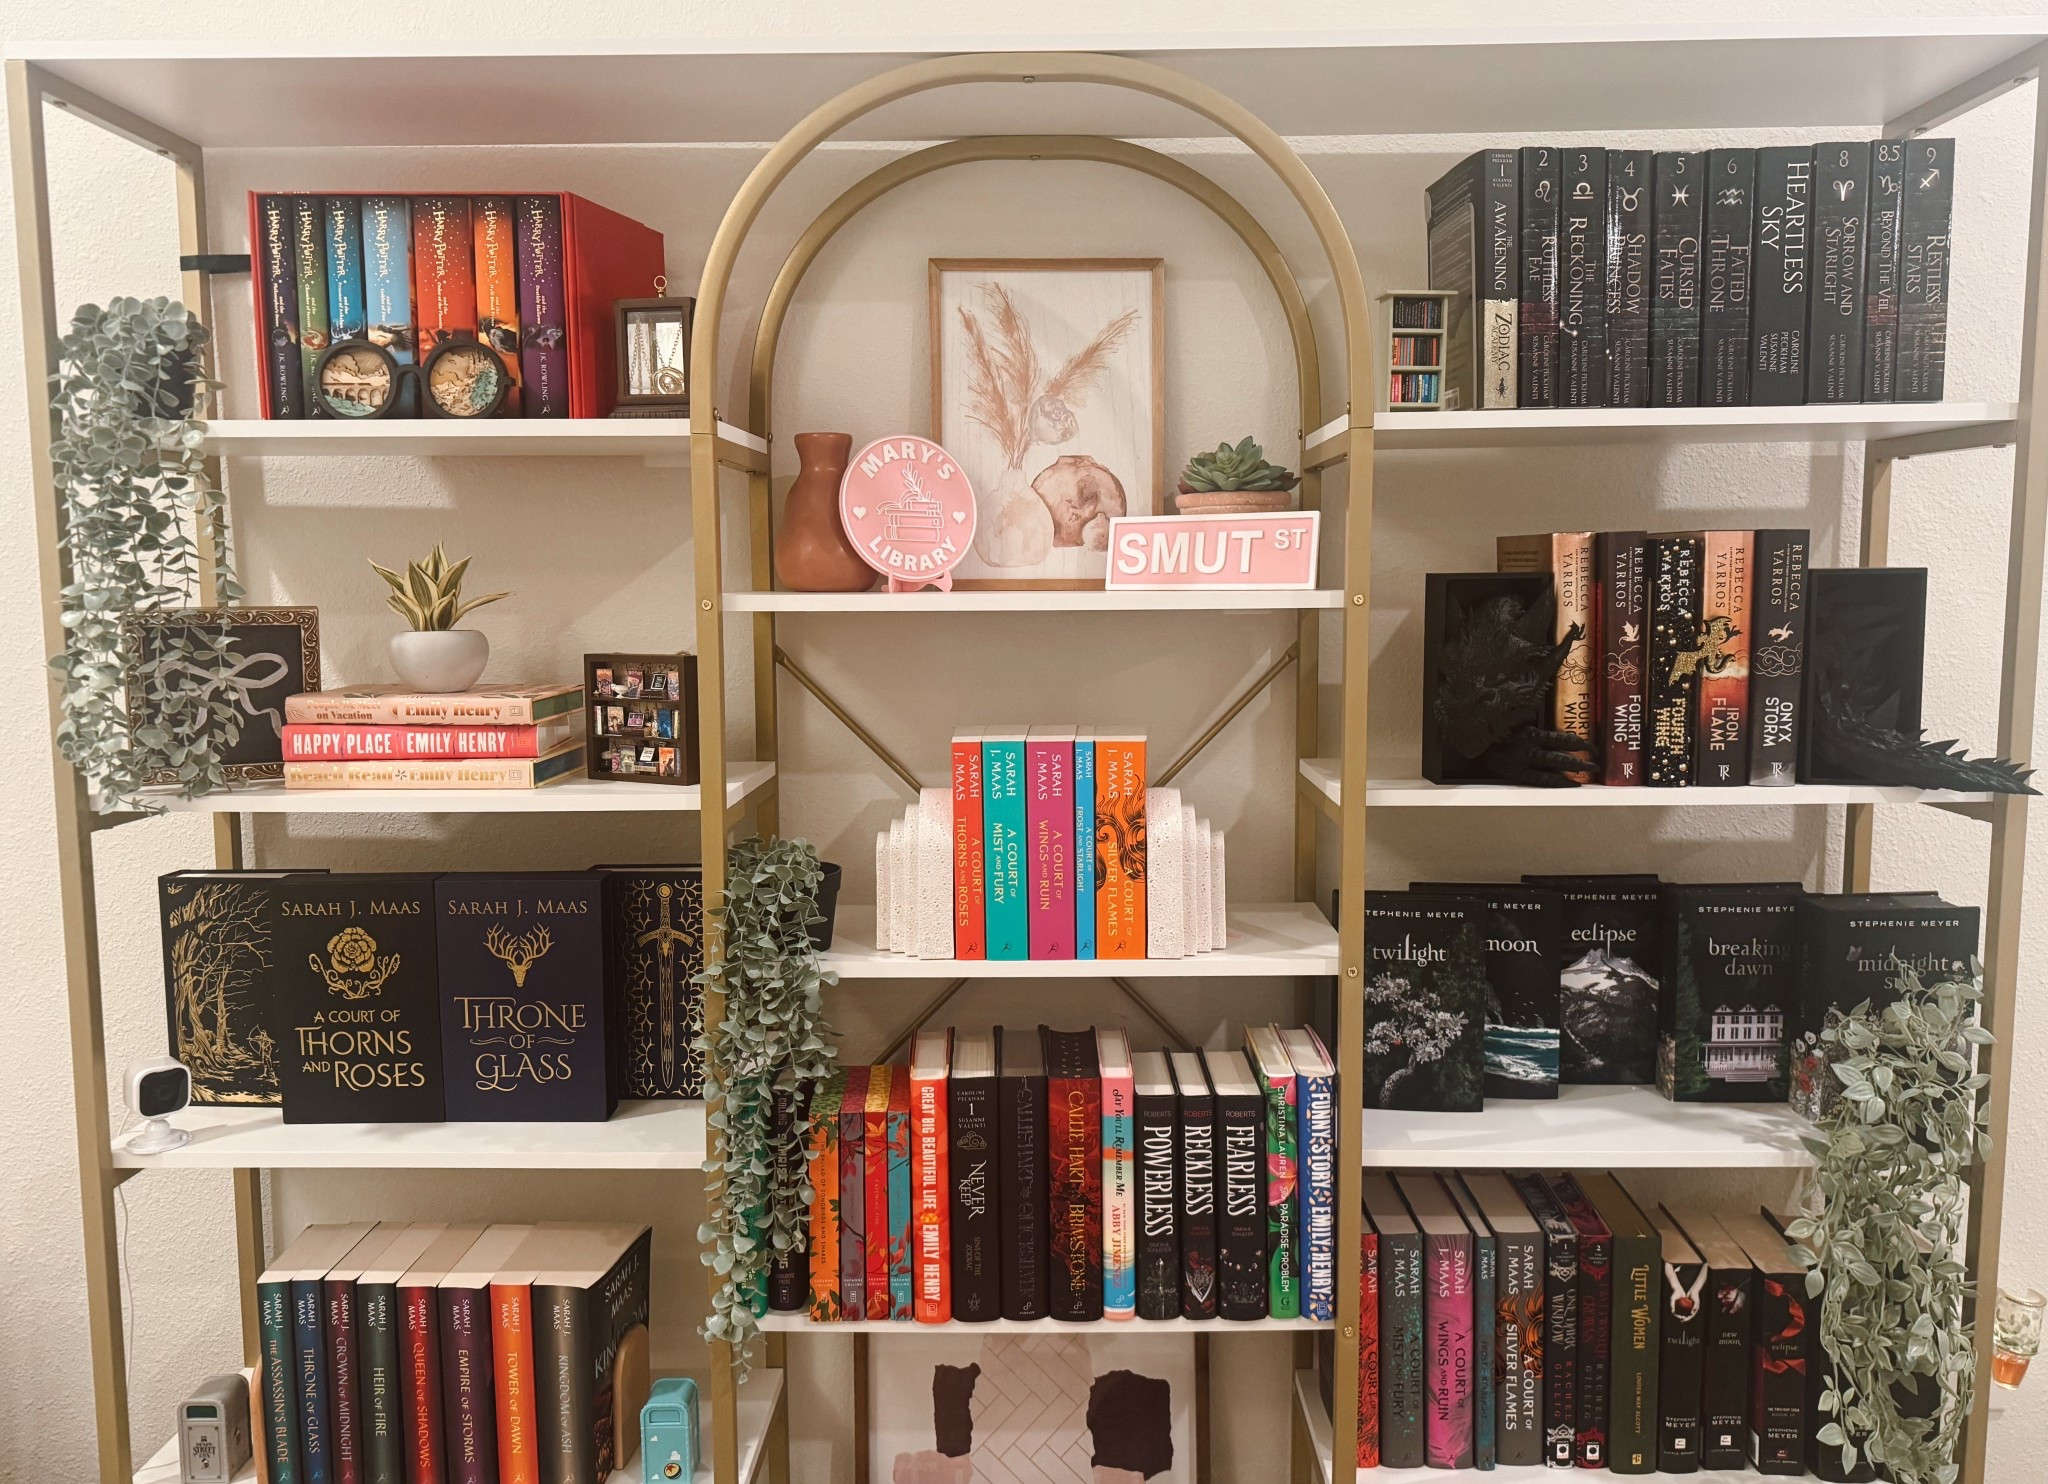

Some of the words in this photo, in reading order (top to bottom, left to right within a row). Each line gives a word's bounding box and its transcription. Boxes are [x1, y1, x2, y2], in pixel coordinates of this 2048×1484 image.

[1539, 151, 1549, 167] 2
[1926, 147, 1937, 165] 9
[1494, 200, 1507, 291] AWAKENING
[1761, 206, 1783, 251] SKY
[1783, 161, 1809, 294] HEARTLESS
[1841, 216, 1859, 279] SORROW
[1879, 210, 1894, 259] BEYOND
[1528, 256, 1542, 281] FAE
[1541, 236, 1557, 302] RUTHLESS
[1567, 217, 1588, 325] RECKONING
[1584, 260, 1597, 282] THE
[1607, 235, 1626, 314] PRINCESS
[1625, 233, 1645, 314] SHADOW
[1660, 248, 1678, 299] FATES
[1678, 237, 1698, 309] CURSED
[1709, 235, 1730, 313] THRONE
[1729, 245, 1749, 302] FATED
[1824, 227, 1841, 305] STARLIGHT
[1879, 262, 1892, 284] THE
[1905, 244, 1922, 293] STARS
[1925, 234, 1946, 304] RESTLESS
[1840, 284, 1853, 316] AND
[1878, 288, 1891, 313] VEIL
[1495, 313, 1512, 371] ZODIAC
[1759, 334, 1768, 371] VALENTI
[1769, 332, 1778, 372] SUSANNE
[1780, 331, 1789, 373] PECKHAM
[1790, 329, 1800, 374] CAROLINE
[541, 364, 550, 401] ROWLING
[858, 440, 954, 481] MARY'S
[866, 534, 960, 572] LIBRARY
[1117, 528, 1264, 576] SMUT
[1274, 528, 1307, 550] ST
[1771, 549, 1784, 605] YARROS
[1789, 544, 1803, 611] REBECCA
[316, 711, 329, 720] on
[332, 710, 373, 720] Vacation
[405, 702, 447, 719] Emily
[453, 702, 502, 719] Henry
[1613, 704, 1628, 743] WING
[1627, 694, 1641, 751] FOURTH
[1710, 697, 1726, 751] FLAME
[1726, 707, 1739, 741] IRON
[1763, 697, 1778, 747] STORM
[1778, 702, 1793, 742] ONYX
[293, 733, 341, 755] HAPPY
[346, 733, 392, 754] PLACE
[406, 732, 452, 753] EMILY
[458, 732, 506, 753] HENRY
[990, 749, 1000, 757] J.
[991, 760, 1001, 799] MAAS
[1005, 751, 1016, 796] SARAH
[957, 815, 968, 868] THORNS
[993, 821, 1003, 853] MIST
[1007, 828, 1017, 838] A
[1039, 819, 1049, 861] WINGS
[1007, 842, 1018, 887] COURT
[1108, 841, 1118, 883] SILVER
[958, 885, 969, 927] ROSES
[993, 871, 1004, 904] FURY
[1039, 880, 1050, 910] RUIN
[281, 899, 343, 918] SARAH
[347, 899, 362, 919] J.
[369, 899, 421, 915] MAAS
[447, 899, 511, 917] SARAH
[514, 899, 529, 918] J.
[536, 899, 588, 915] MAAS
[1108, 887, 1118, 936] FLAMES
[1426, 910, 1464, 919] MEYER
[1849, 920, 1915, 928] STEPHENIE
[1920, 919, 1960, 927] MEYER
[1371, 932, 1446, 967] twilight
[1570, 921, 1636, 959] eclipse
[1708, 937, 1789, 962] breaking
[1724, 959, 1773, 977] dawn
[313, 1011, 325, 1023] A
[328, 1010, 376, 1023] COURT
[379, 1009, 401, 1022] OF
[453, 996, 586, 1034] THRONE
[294, 1026, 412, 1056] THORNS
[508, 1033, 534, 1048] OF
[302, 1060, 331, 1073] AND
[334, 1061, 425, 1092] ROSES
[474, 1053, 572, 1092] GLASS
[921, 1086, 935, 1116] GREAT
[1068, 1090, 1085, 1142] CALLIE
[1225, 1110, 1256, 1118] ROBERTS
[1277, 1085, 1286, 1138] CHRISTINA
[1311, 1092, 1331, 1137] FUNNY
[921, 1117, 935, 1134] BIG
[922, 1136, 937, 1187] BEAUTIFUL
[1069, 1146, 1084, 1186] HART
[1184, 1124, 1214, 1216] RECKLESS
[1226, 1125, 1256, 1216] FEARLESS
[1278, 1140, 1287, 1178] LAUREN
[1311, 1143, 1331, 1188] STORY
[923, 1189, 937, 1209] LIFE
[958, 1178, 972, 1206] KEEP
[967, 1159, 987, 1220] NEVER
[1143, 1125, 1174, 1237] POWERLESS
[922, 1224, 939, 1260] EMILY
[1279, 1202, 1289, 1249] PARADISE
[1311, 1205, 1331, 1246] EMILY
[1069, 1203, 1086, 1291] BRIMSTONE
[924, 1263, 940, 1301] HENRY
[1280, 1250, 1290, 1292] PROBLEM
[1311, 1251, 1331, 1294] HENRY
[1632, 1264, 1650, 1301] LITTLE
[407, 1305, 416, 1330] MAAS
[418, 1298, 427, 1328] SARAH
[1551, 1294, 1564, 1345] WINDOW
[1563, 1288, 1576, 1312] ONE
[1506, 1323, 1517, 1370] SILVER
[1563, 1317, 1576, 1350] DARK
[1631, 1304, 1651, 1349] WOMEN
[269, 1339, 277, 1355] THE
[271, 1356, 286, 1423] ASSASSIN'S
[373, 1367, 385, 1396] HEIR
[507, 1351, 519, 1395] TOWER
[1554, 1363, 1562, 1418] GILLIG
[1564, 1360, 1572, 1420] RACHEL
[375, 1398, 384, 1410] OF
[509, 1399, 518, 1412] OF
[1505, 1375, 1517, 1431] FLAMES
[276, 1426, 289, 1463] BLADE
[375, 1412, 386, 1437] FIRE
[509, 1416, 522, 1454] DAWN
